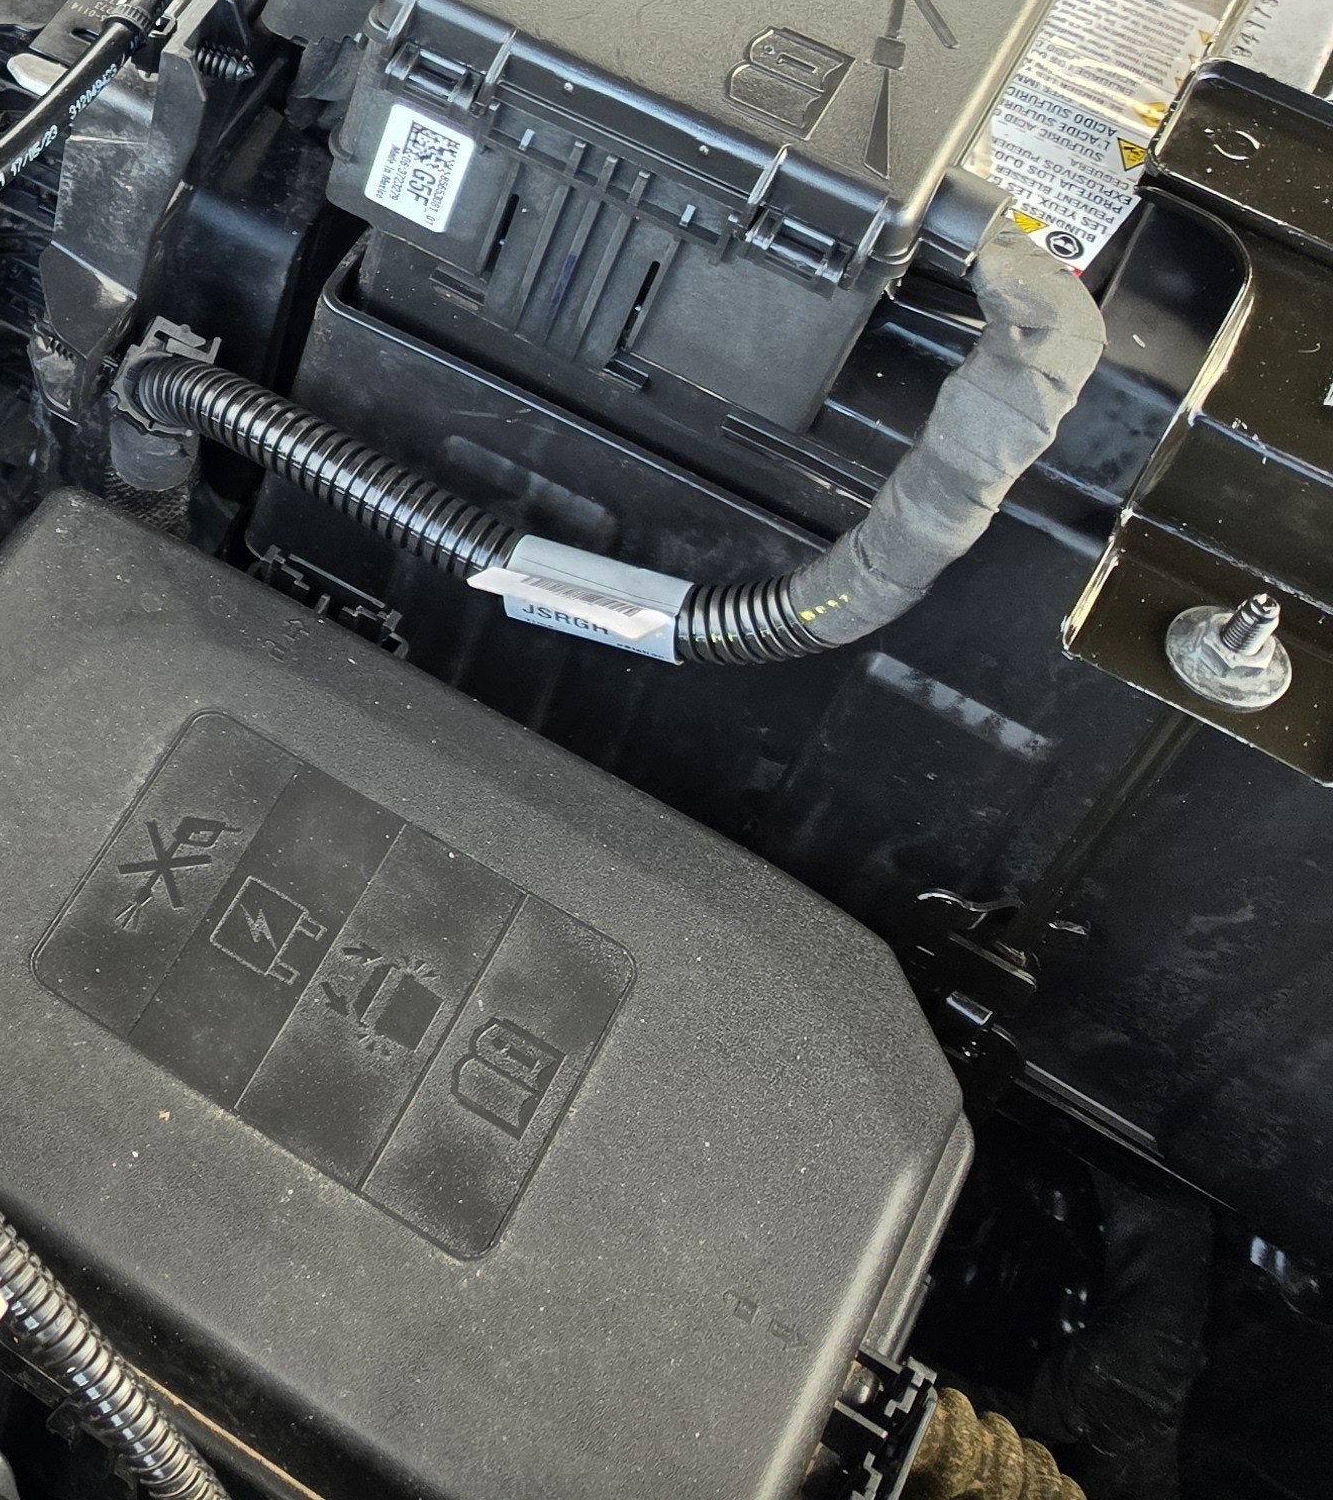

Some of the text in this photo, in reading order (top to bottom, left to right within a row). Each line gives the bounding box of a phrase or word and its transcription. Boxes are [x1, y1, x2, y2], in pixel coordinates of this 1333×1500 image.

[1003, 110, 1036, 133] ACID
[1056, 118, 1111, 153] L'ACIDE
[1037, 124, 1104, 165] SULFURIC
[376, 175, 391, 199] Mexico
[407, 168, 436, 207] G5F
[1004, 180, 1032, 200] LES
[1026, 163, 1055, 183] LOS
[1042, 156, 1132, 208] EXPLOSIVOS
[994, 162, 1114, 224] PEUVENT BLESSER
[1033, 193, 1078, 222] YEUX.
[1057, 177, 1122, 215] PROTEJA
[1019, 200, 1096, 244] BLINDNESS
[1079, 215, 1107, 235] LES
